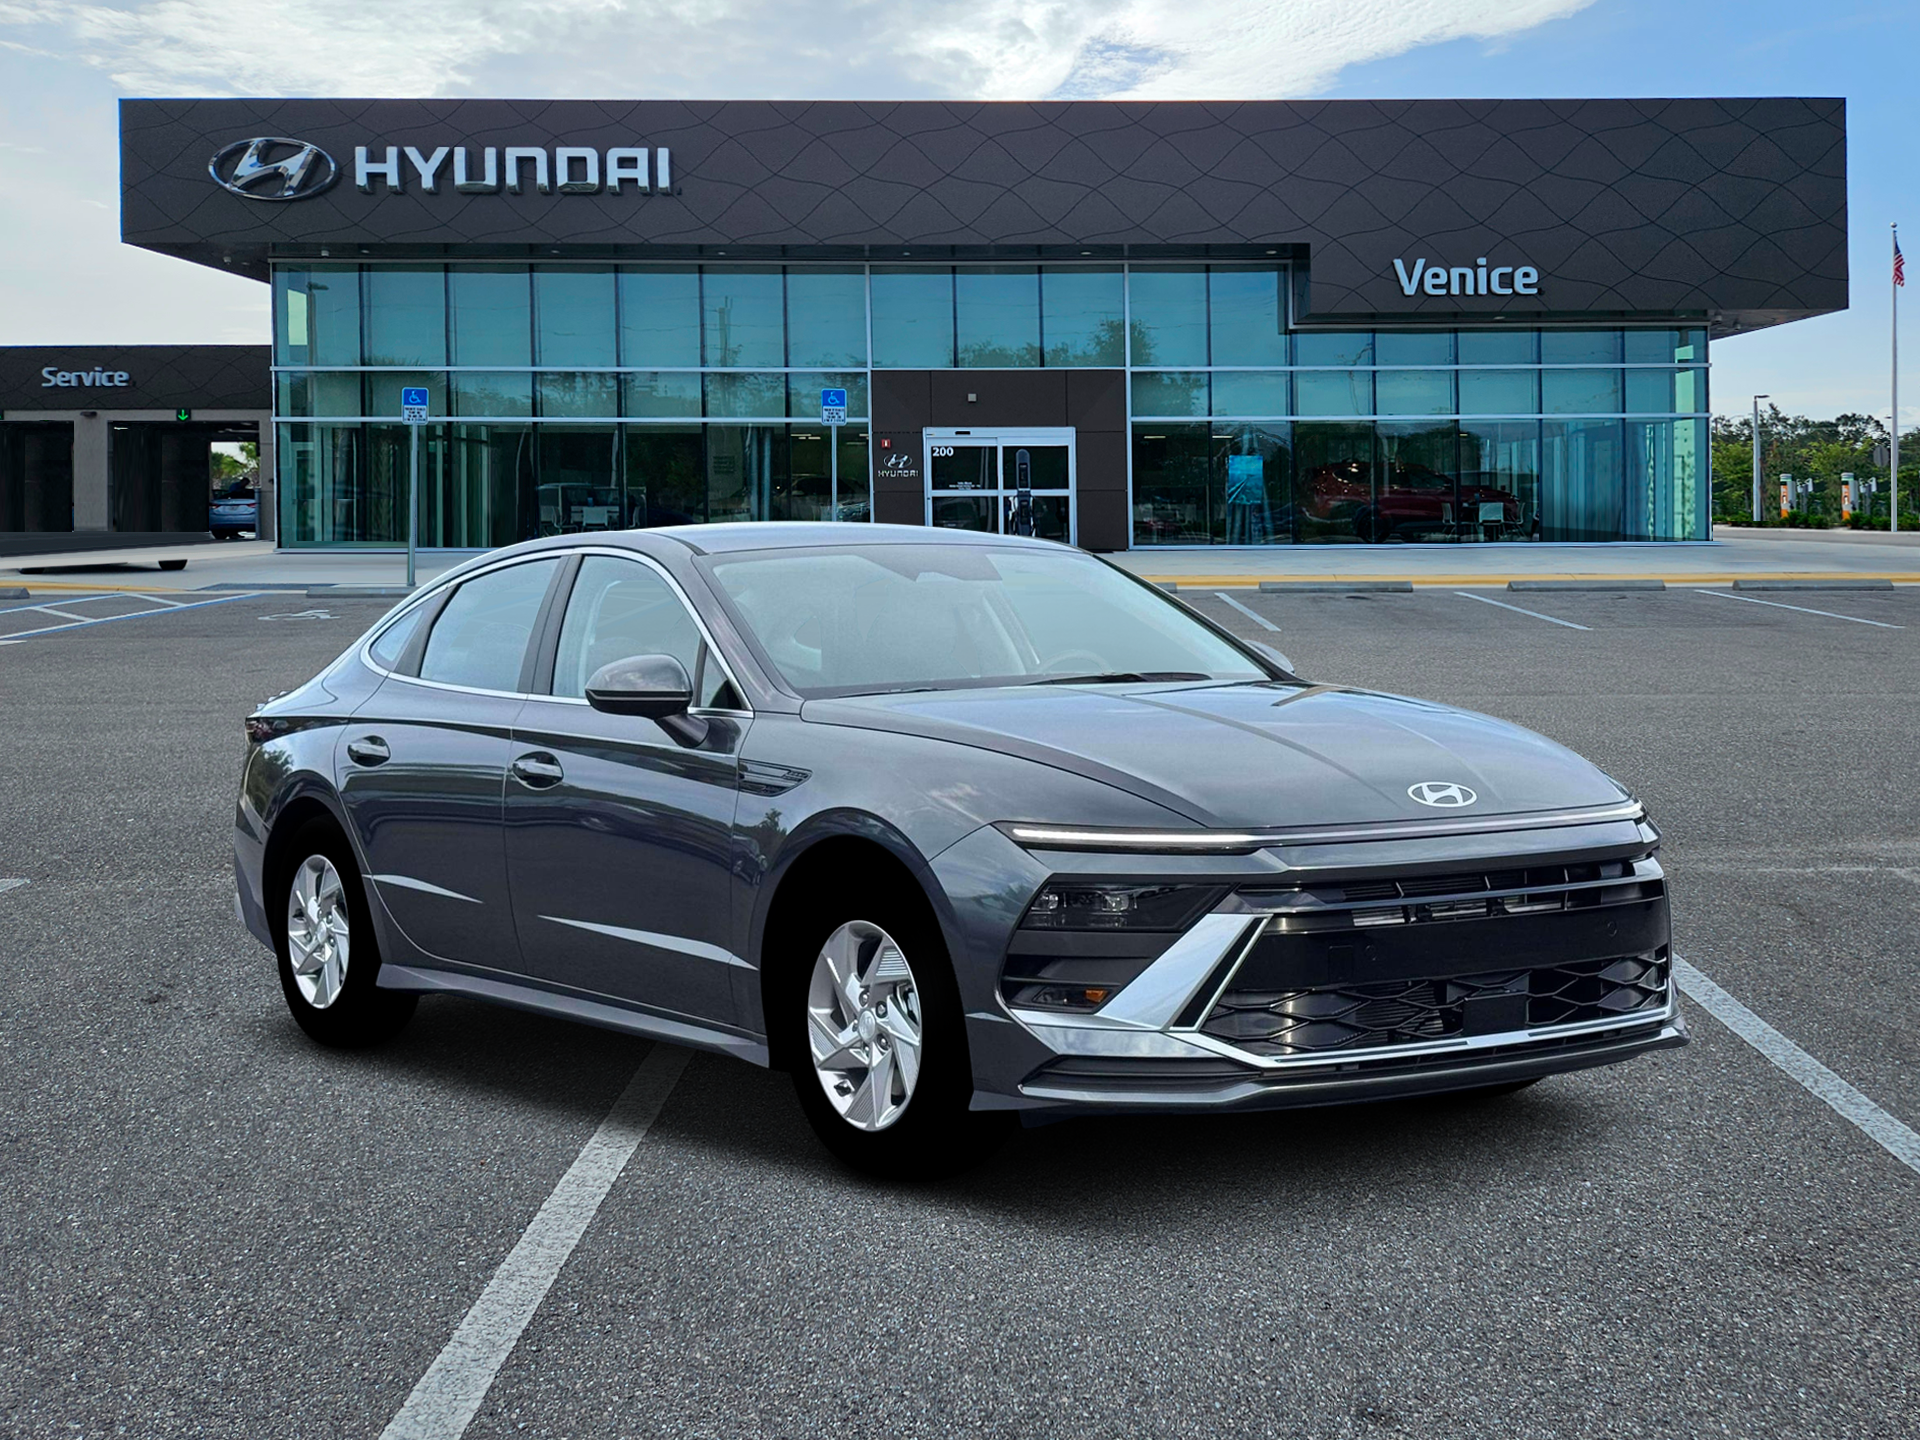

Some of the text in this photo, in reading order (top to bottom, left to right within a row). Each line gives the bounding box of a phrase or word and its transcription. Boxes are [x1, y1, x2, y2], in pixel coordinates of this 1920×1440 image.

[355, 146, 672, 193] HYUNDAI
[1392, 257, 1539, 296] Venice
[41, 366, 130, 388] Service
[932, 446, 954, 457] 200
[877, 470, 919, 478] HYUNDAI
